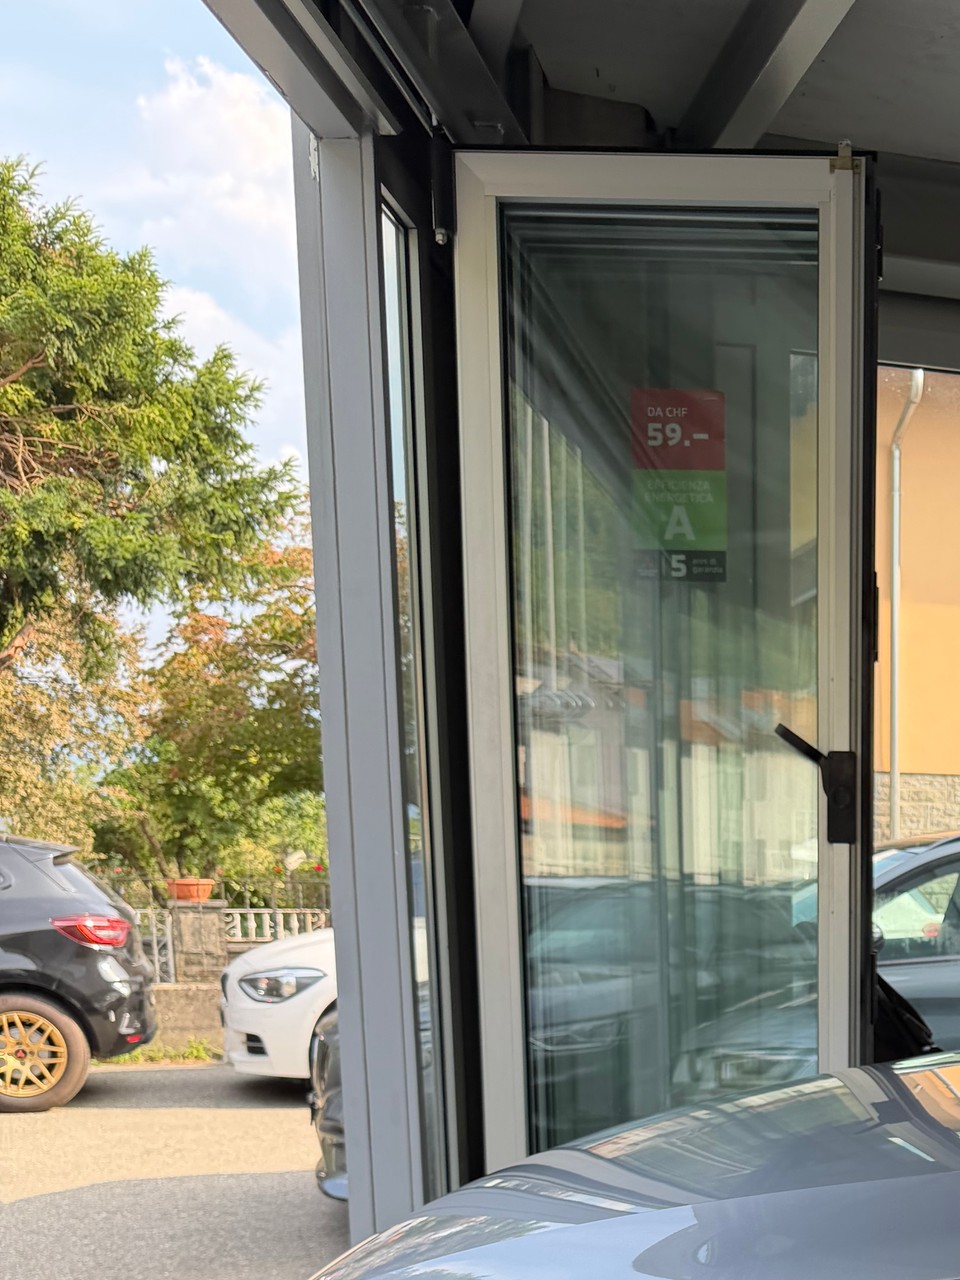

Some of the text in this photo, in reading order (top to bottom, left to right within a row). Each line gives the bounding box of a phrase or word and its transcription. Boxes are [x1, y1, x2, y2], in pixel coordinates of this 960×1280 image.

[647, 407, 688, 417] DA CHF
[663, 505, 696, 541] A
[670, 555, 687, 578] 5
